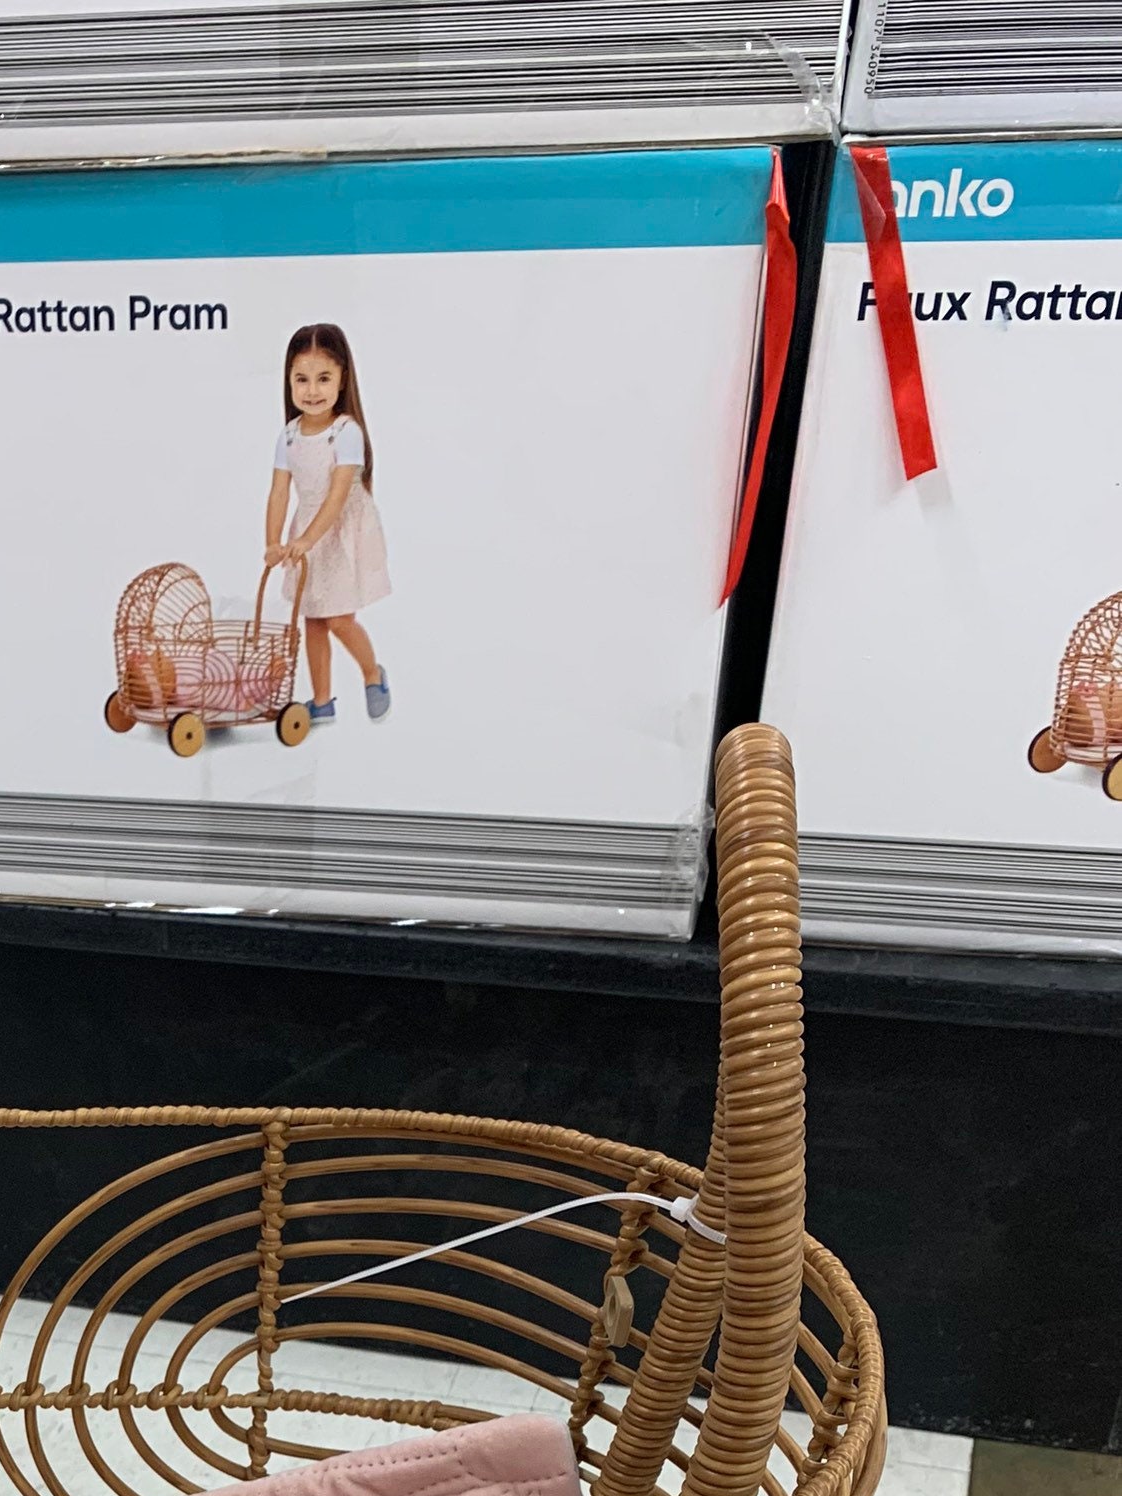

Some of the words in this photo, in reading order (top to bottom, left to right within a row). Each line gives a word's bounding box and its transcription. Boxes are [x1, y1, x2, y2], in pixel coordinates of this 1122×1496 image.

[874, 0, 887, 36] 1107
[863, 44, 881, 95] 340950
[129, 295, 228, 331] Pram
[857, 281, 972, 322] Fux
[984, 280, 1122, 321] Ratta
